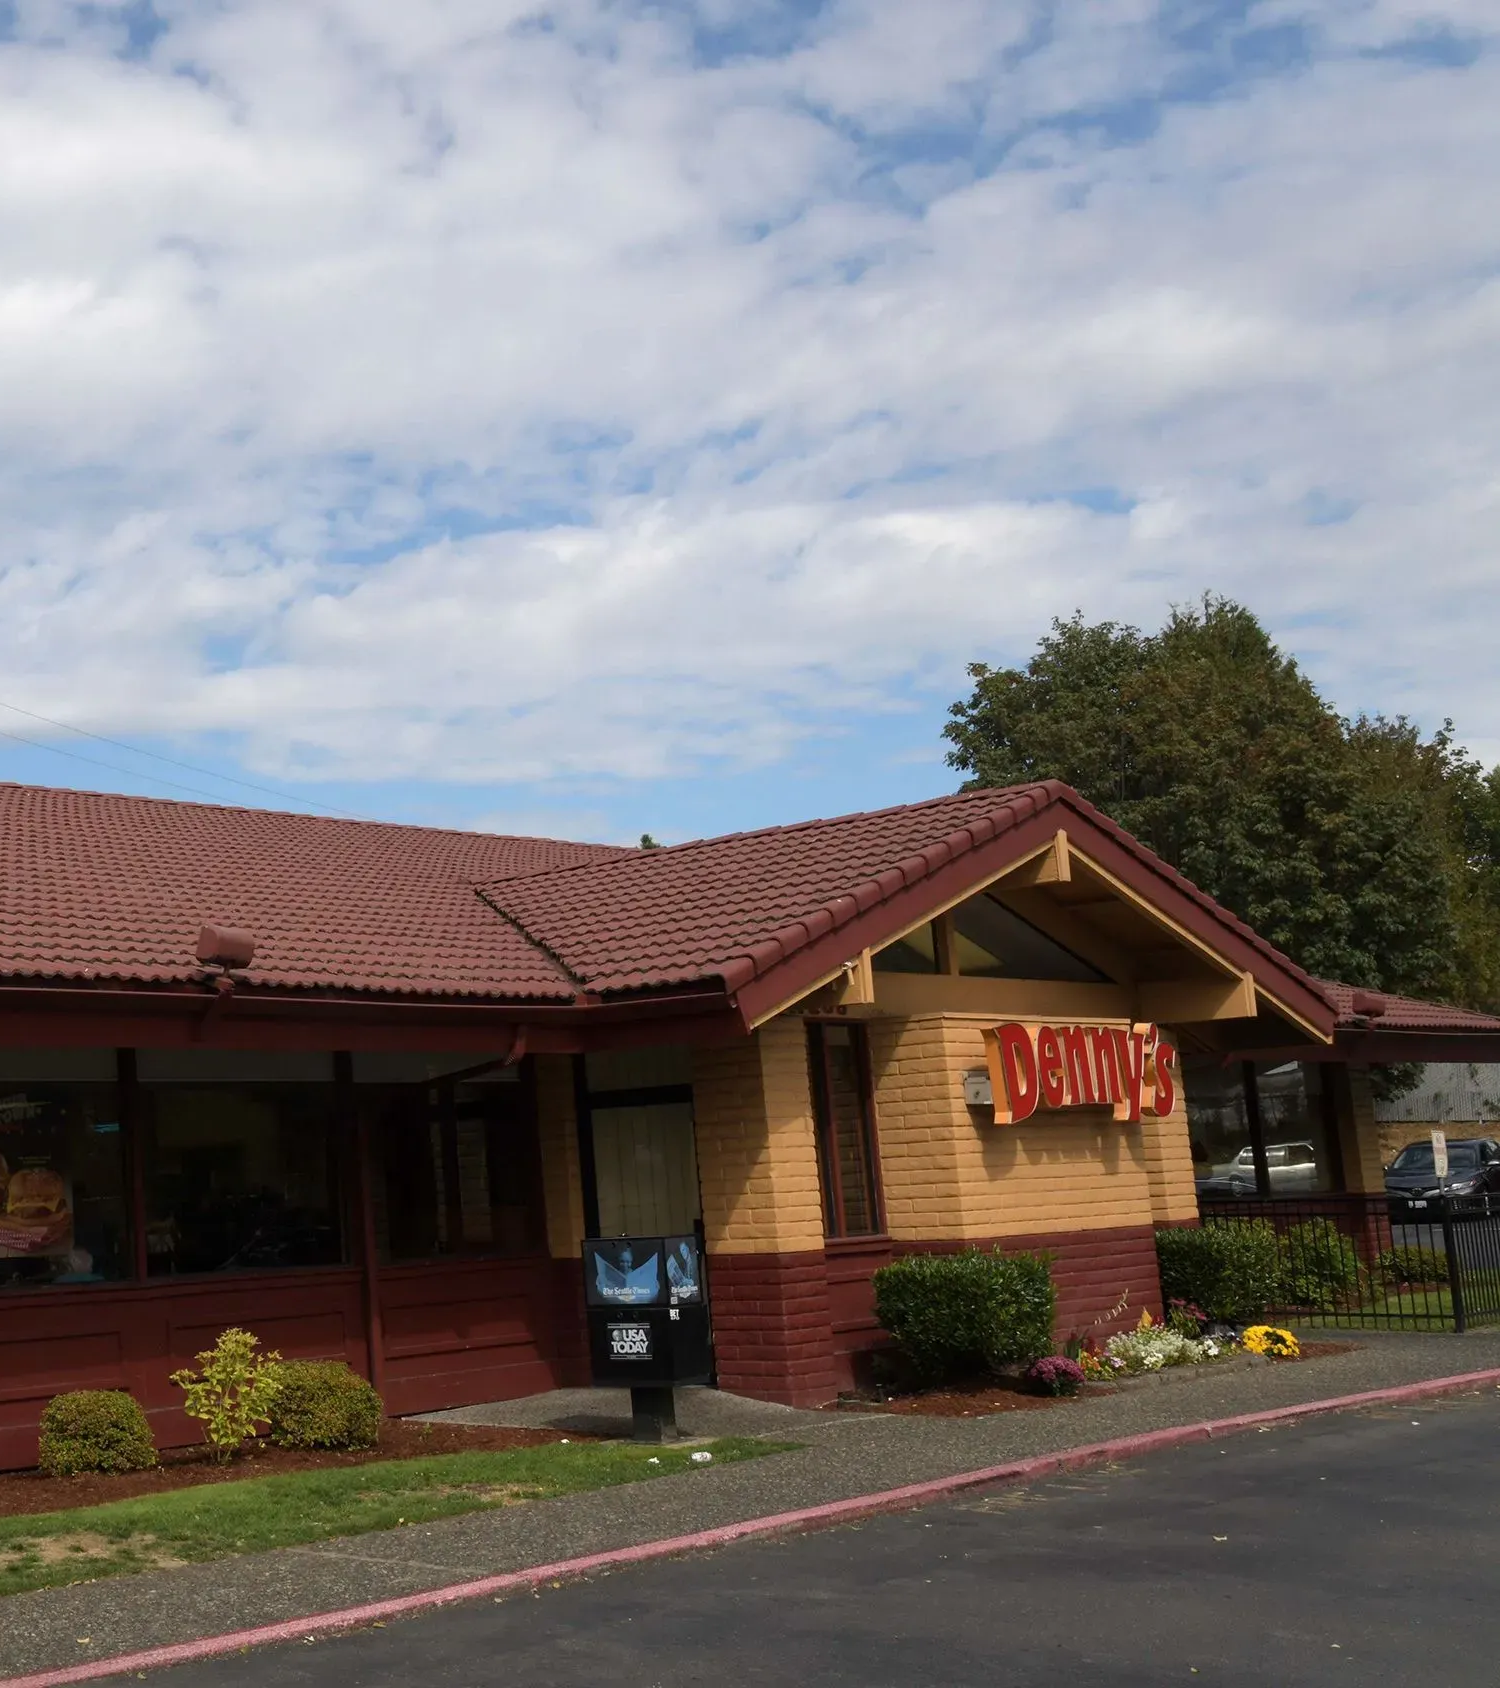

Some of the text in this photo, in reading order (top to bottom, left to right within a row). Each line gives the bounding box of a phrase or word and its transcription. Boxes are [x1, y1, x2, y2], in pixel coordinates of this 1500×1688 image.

[982, 1022, 1176, 1124] Denny's
[603, 1287, 614, 1296] The
[622, 1329, 647, 1342] USA
[611, 1341, 649, 1354] TODAY
